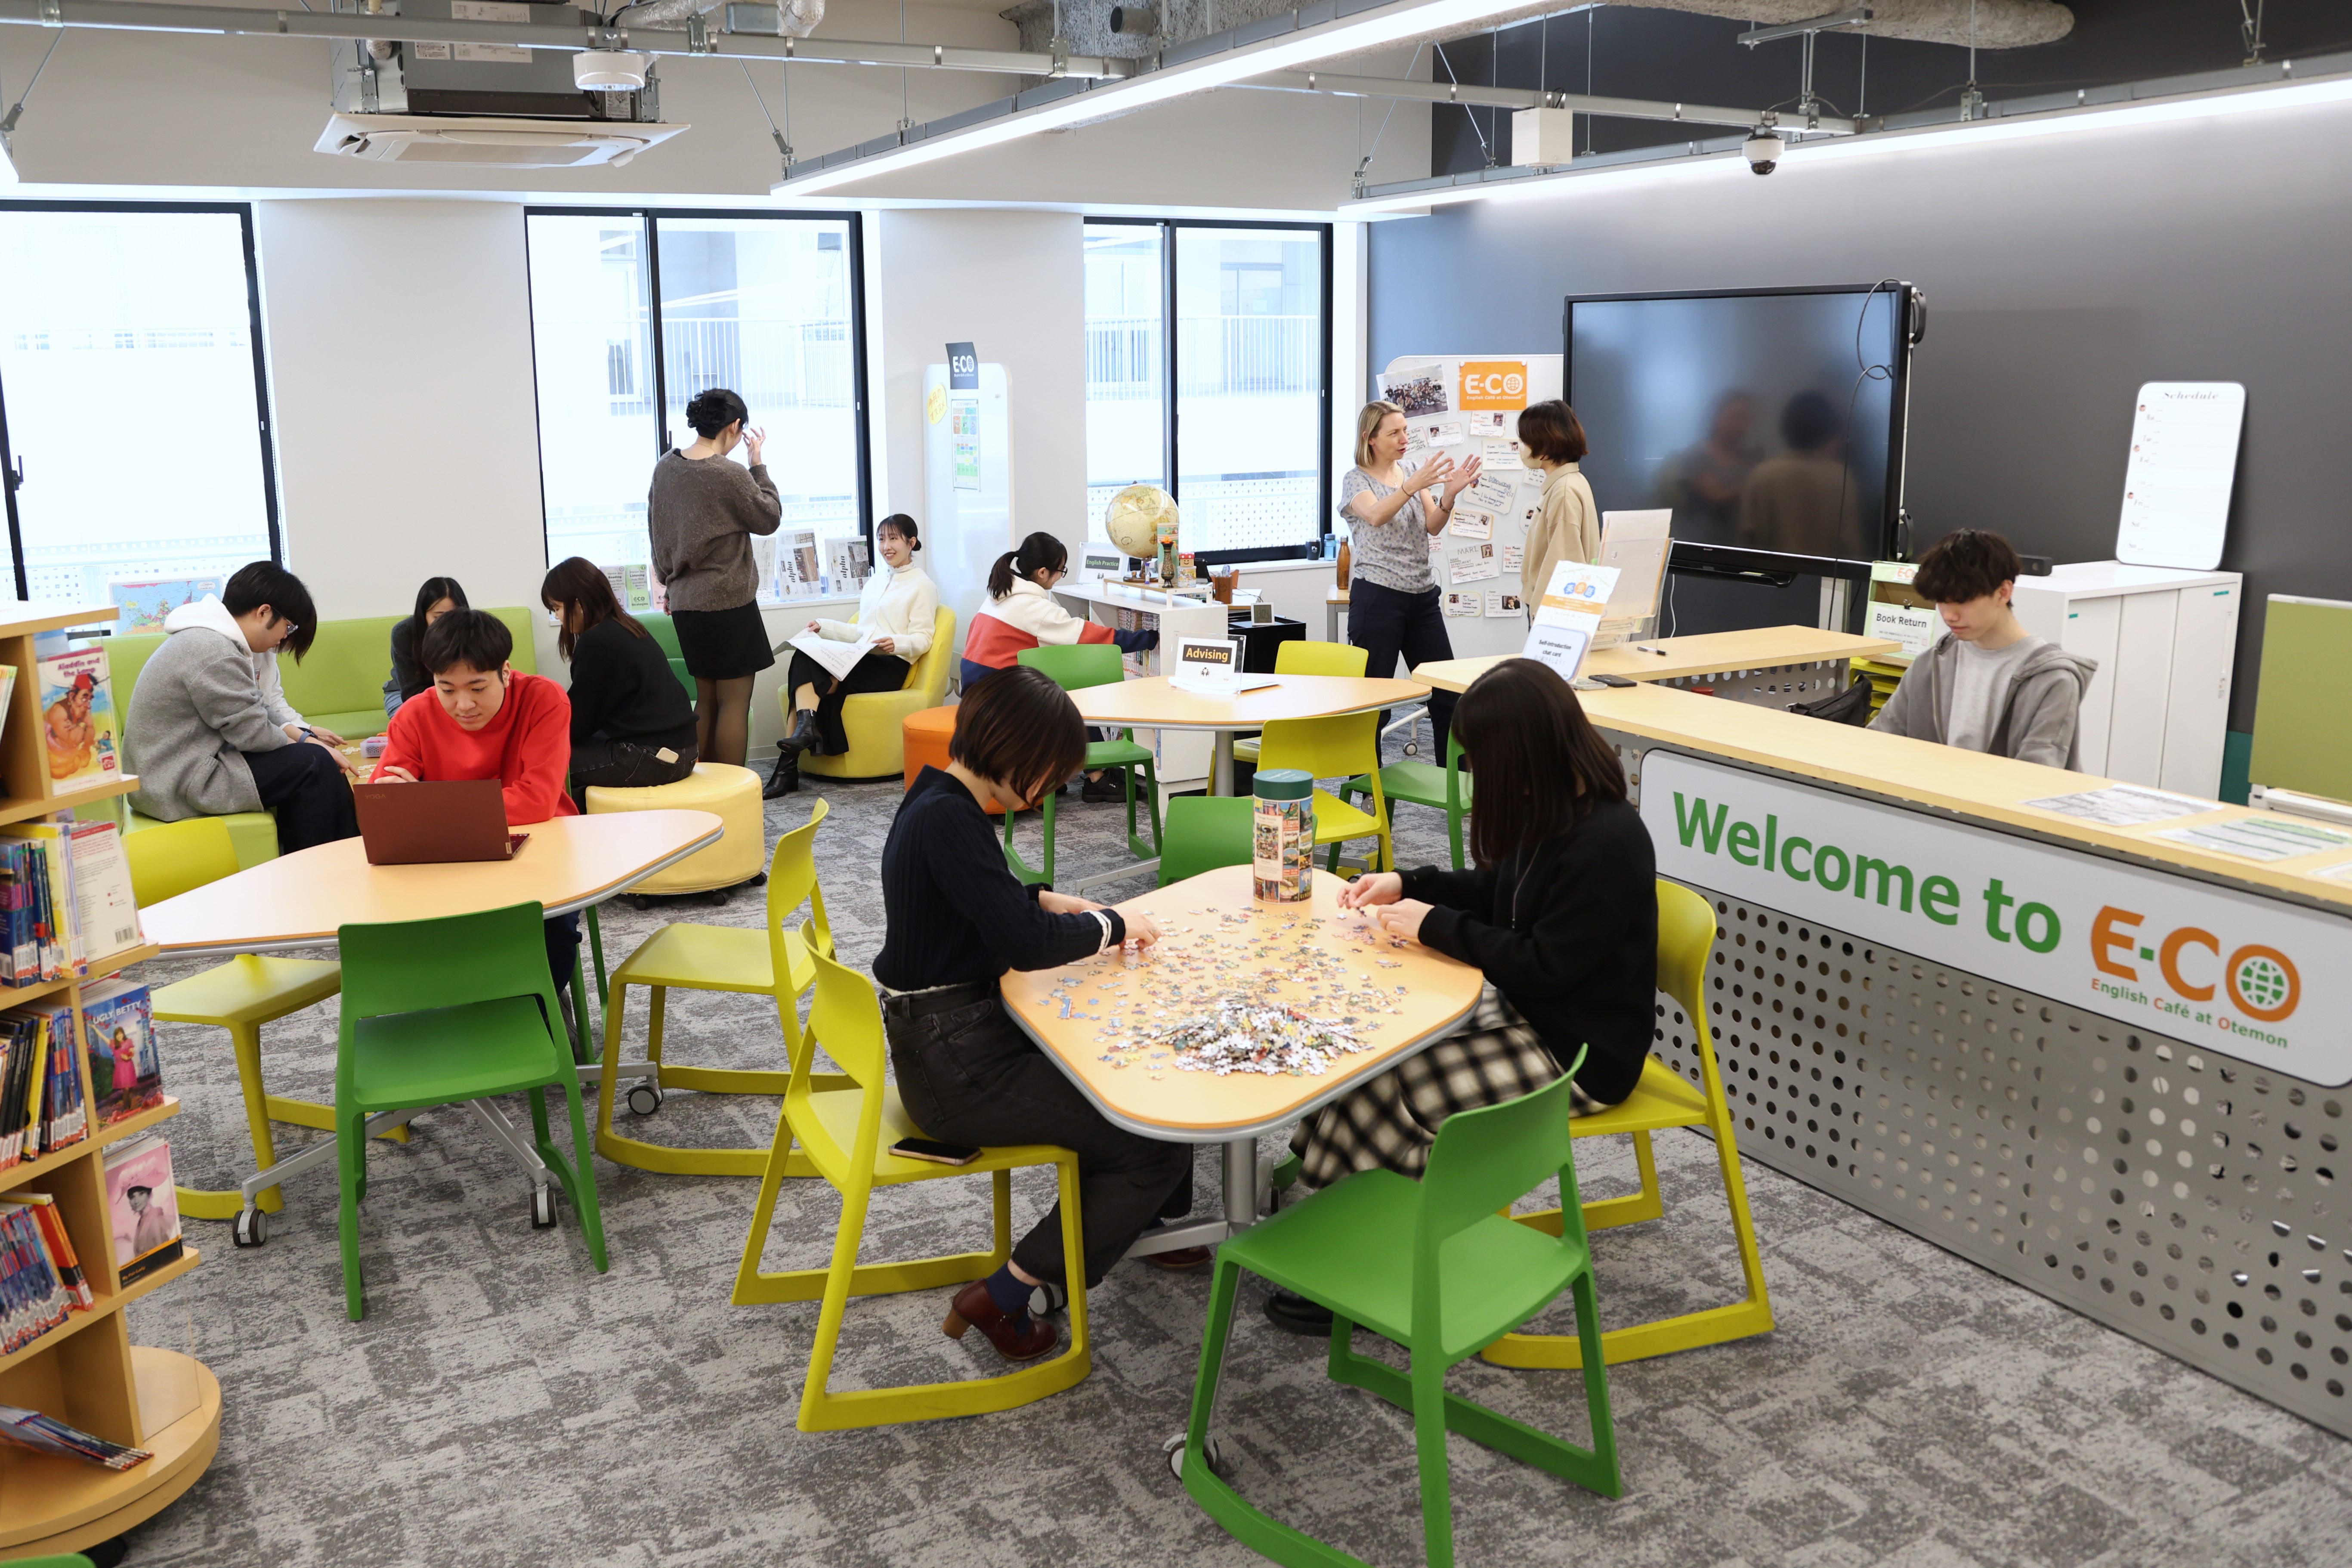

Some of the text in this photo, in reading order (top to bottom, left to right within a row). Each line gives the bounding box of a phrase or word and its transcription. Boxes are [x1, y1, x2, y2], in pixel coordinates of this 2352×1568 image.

[953, 355, 974, 373] E-CO
[1465, 374, 1523, 394] E-CO
[2162, 391, 2219, 400] Schedule
[787, 561, 796, 582] alpha
[840, 556, 848, 578] alpha
[1876, 613, 1927, 628] Book Return
[1539, 640, 1571, 649] Self-introduction
[1186, 647, 1228, 662] Advising
[58, 660, 85, 670] Aladdin
[1673, 791, 2301, 1023] Welcome to E-CO
[93, 1000, 142, 1024] UGLY BETTY
[2091, 977, 2289, 1049] English Café at Otemon
